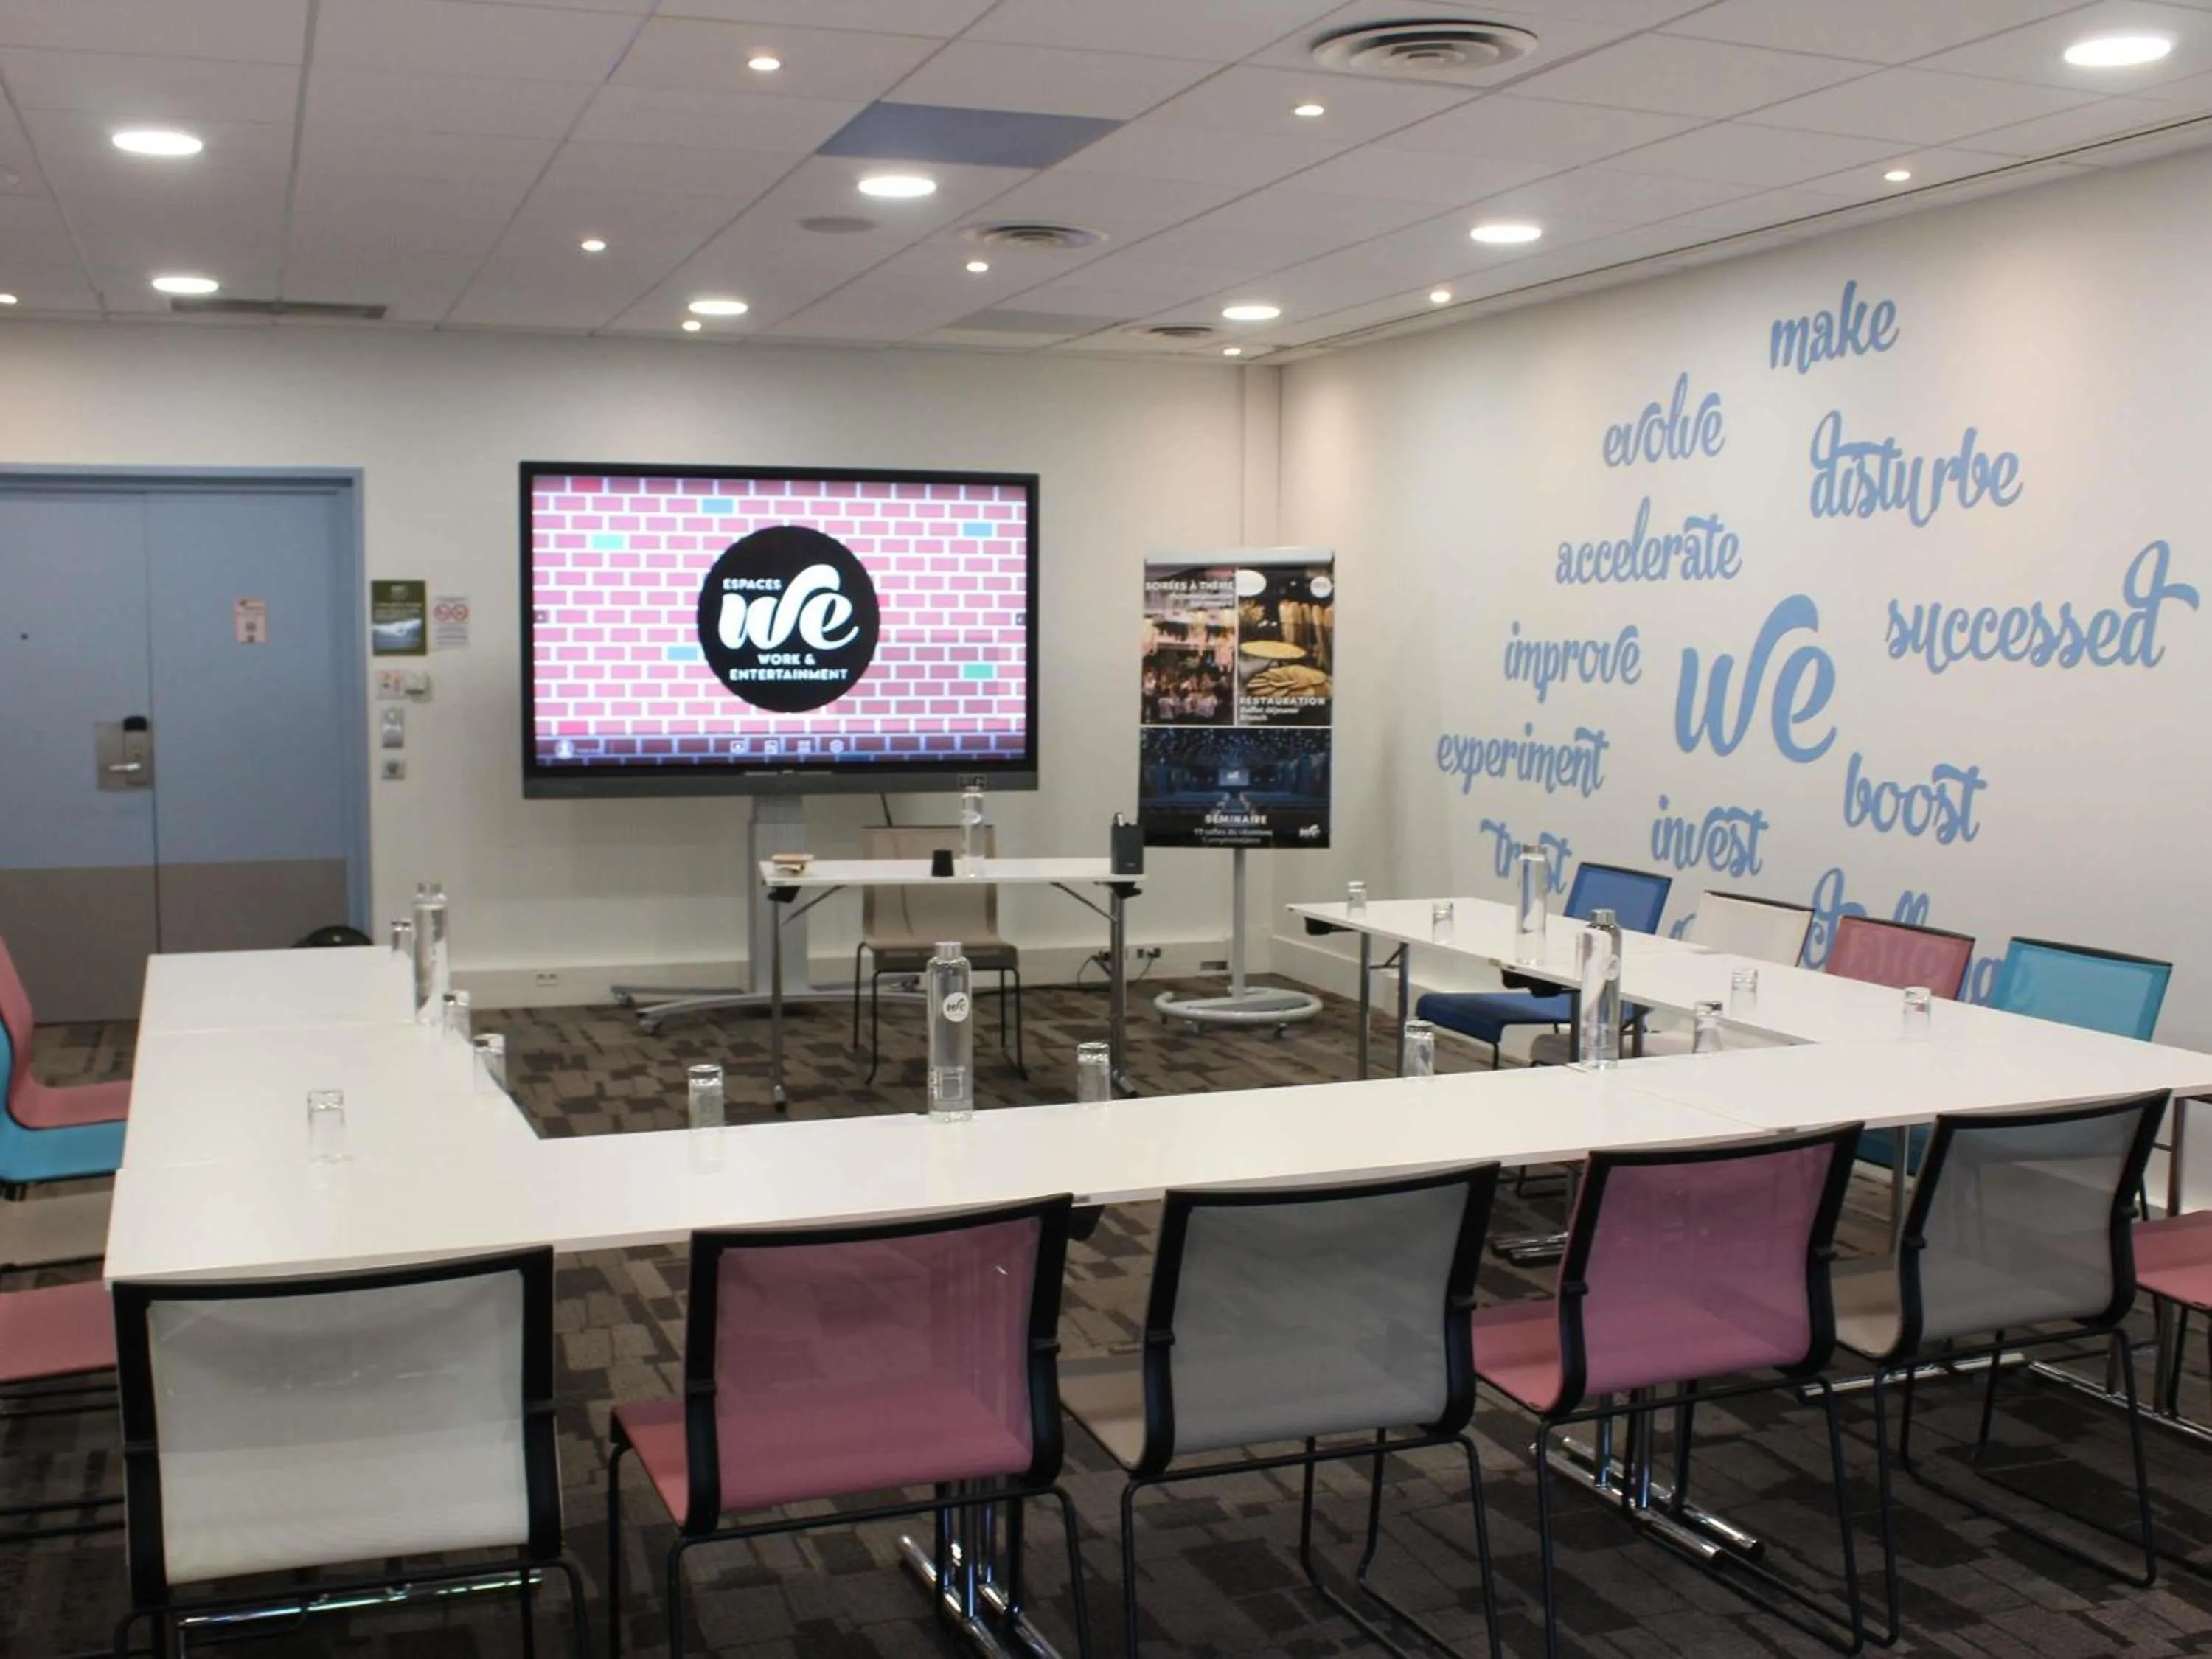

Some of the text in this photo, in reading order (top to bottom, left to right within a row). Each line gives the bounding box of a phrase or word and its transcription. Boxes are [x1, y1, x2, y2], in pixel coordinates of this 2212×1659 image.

[1770, 280, 1898, 374] make
[1603, 372, 1725, 467] evolve
[1809, 410, 2023, 527] disturbe
[1556, 497, 1742, 585] accelerate
[723, 578, 782, 590] ESPACES
[1885, 540, 2200, 674] successed
[729, 669, 849, 681] ENTERTAINMENT
[757, 653, 816, 665] WORK &
[1503, 622, 1643, 704] improve
[1436, 723, 1609, 799] experiment
[1843, 752, 1987, 845] boost
[1479, 818, 1573, 895] trt
[1651, 795, 1770, 877] invest
